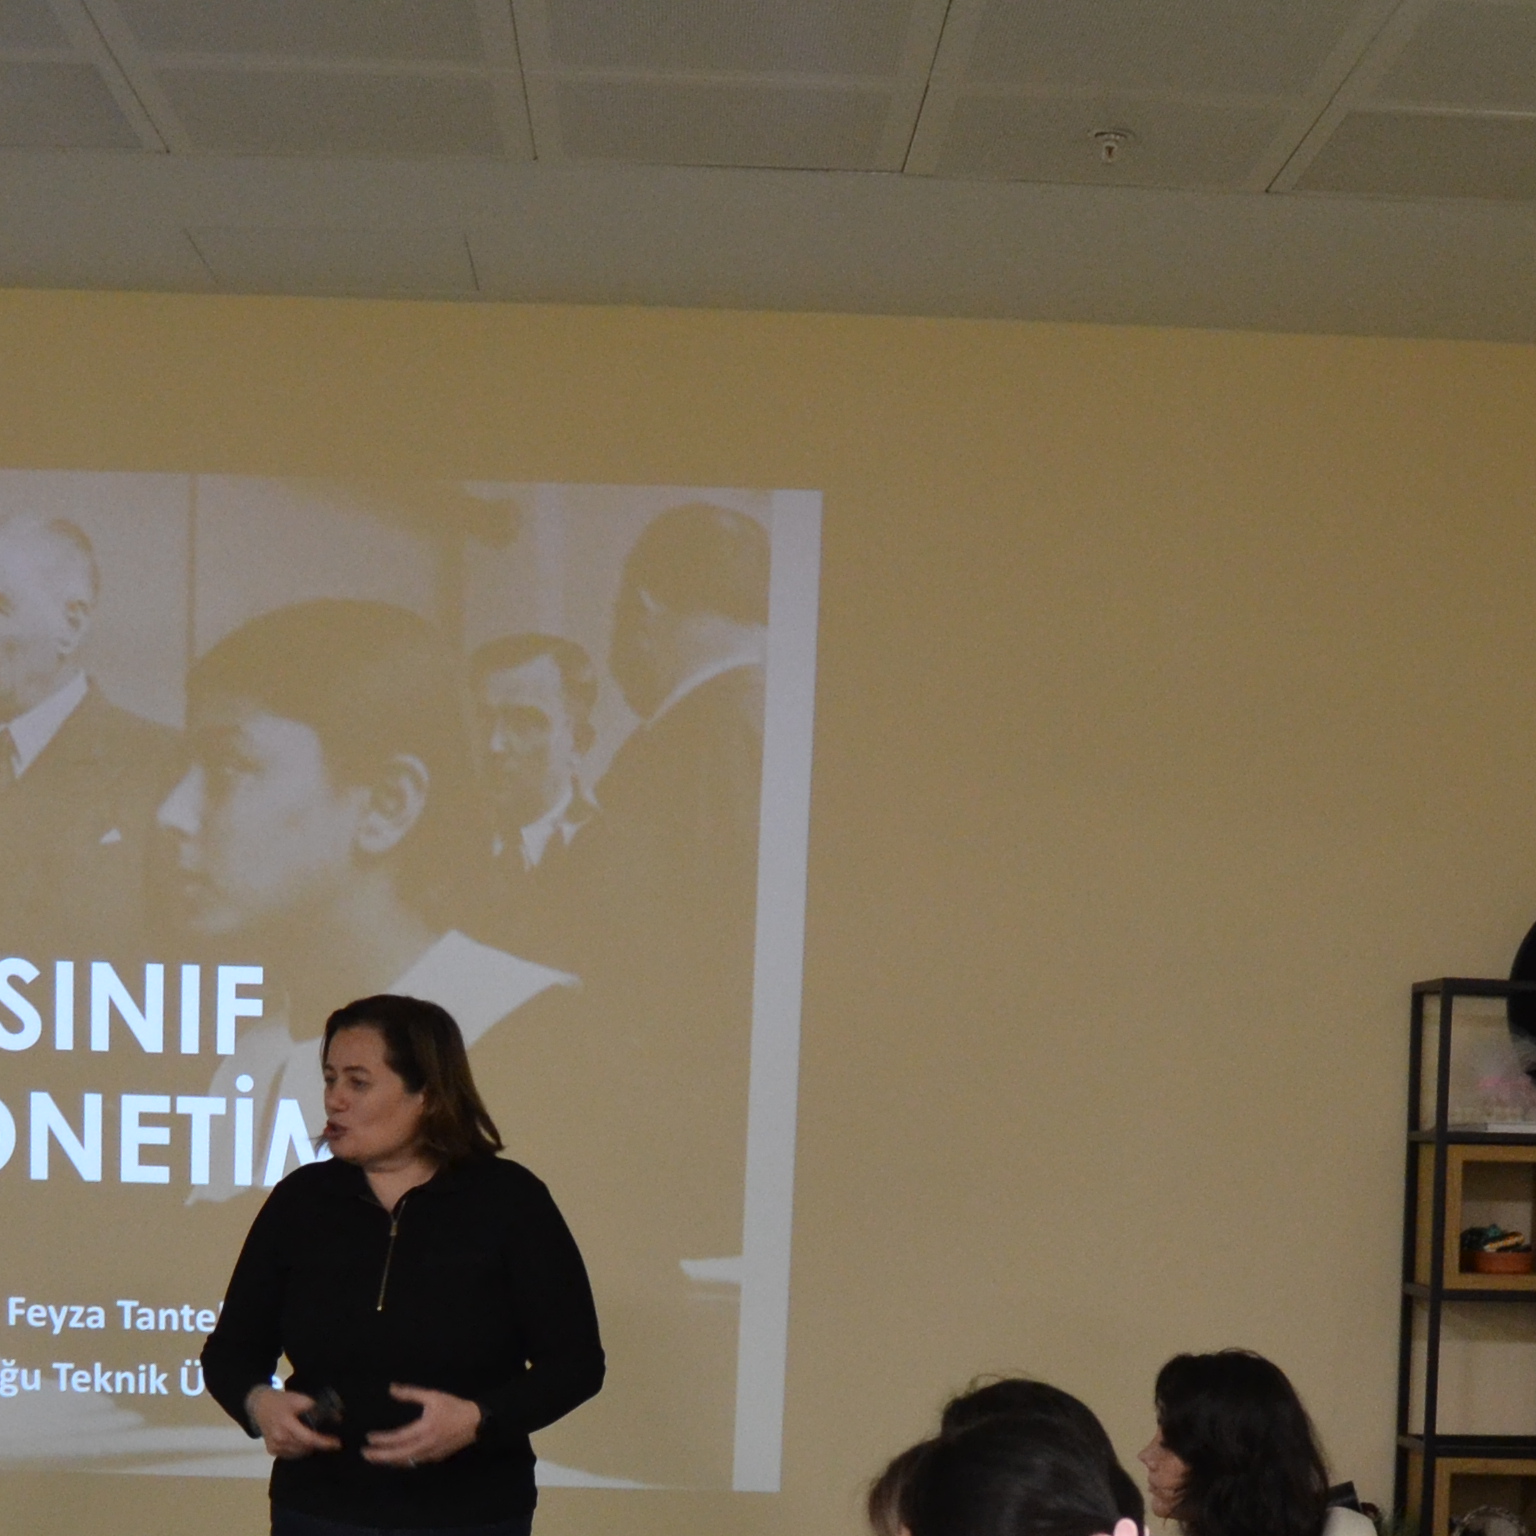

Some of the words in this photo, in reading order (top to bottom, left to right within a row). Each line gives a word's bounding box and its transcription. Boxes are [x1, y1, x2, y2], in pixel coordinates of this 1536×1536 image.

[7, 1296, 105, 1335] Feyza
[116, 1300, 224, 1333] Tante
[52, 1362, 168, 1395] Teknik
